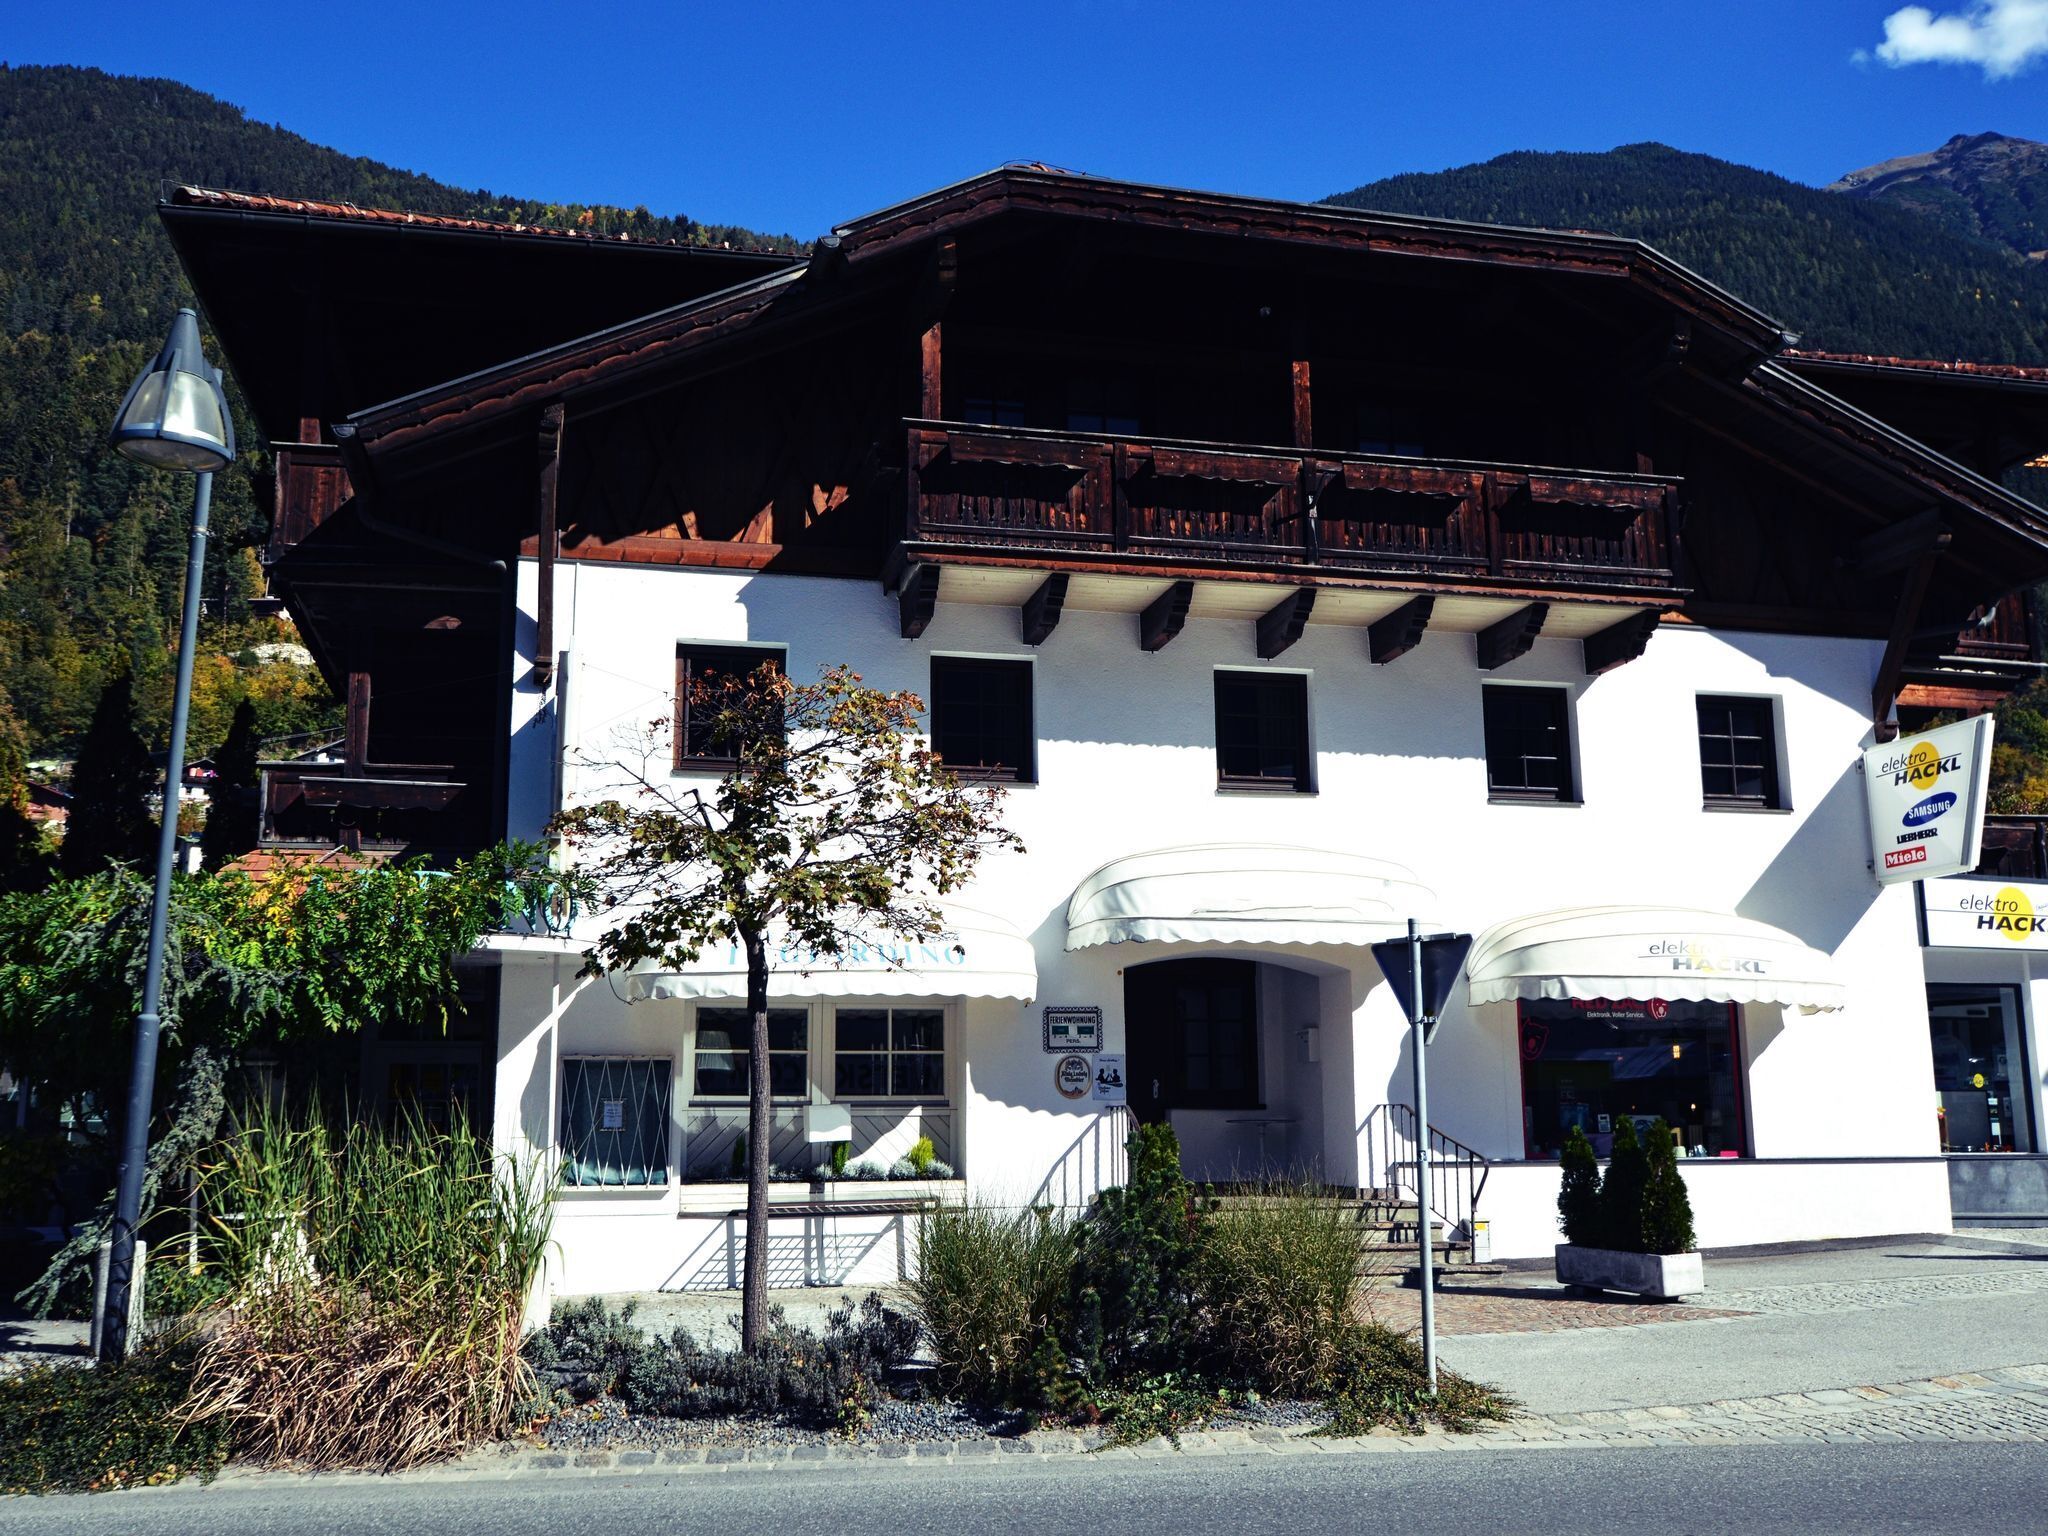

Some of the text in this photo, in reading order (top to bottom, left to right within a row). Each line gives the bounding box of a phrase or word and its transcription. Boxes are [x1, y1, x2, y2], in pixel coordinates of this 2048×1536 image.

[1881, 751, 1927, 773] elektro
[1894, 757, 1961, 787] HACKL
[1908, 800, 1951, 819] SAMSUNG
[1896, 828, 1938, 844] LIEBHERR
[1885, 848, 1925, 866] Miele
[1960, 894, 2019, 912] elektro
[1977, 915, 2048, 932] HACK
[1672, 958, 1766, 974] HACKL
[1049, 1015, 1096, 1024] FERIENWOHNUNG
